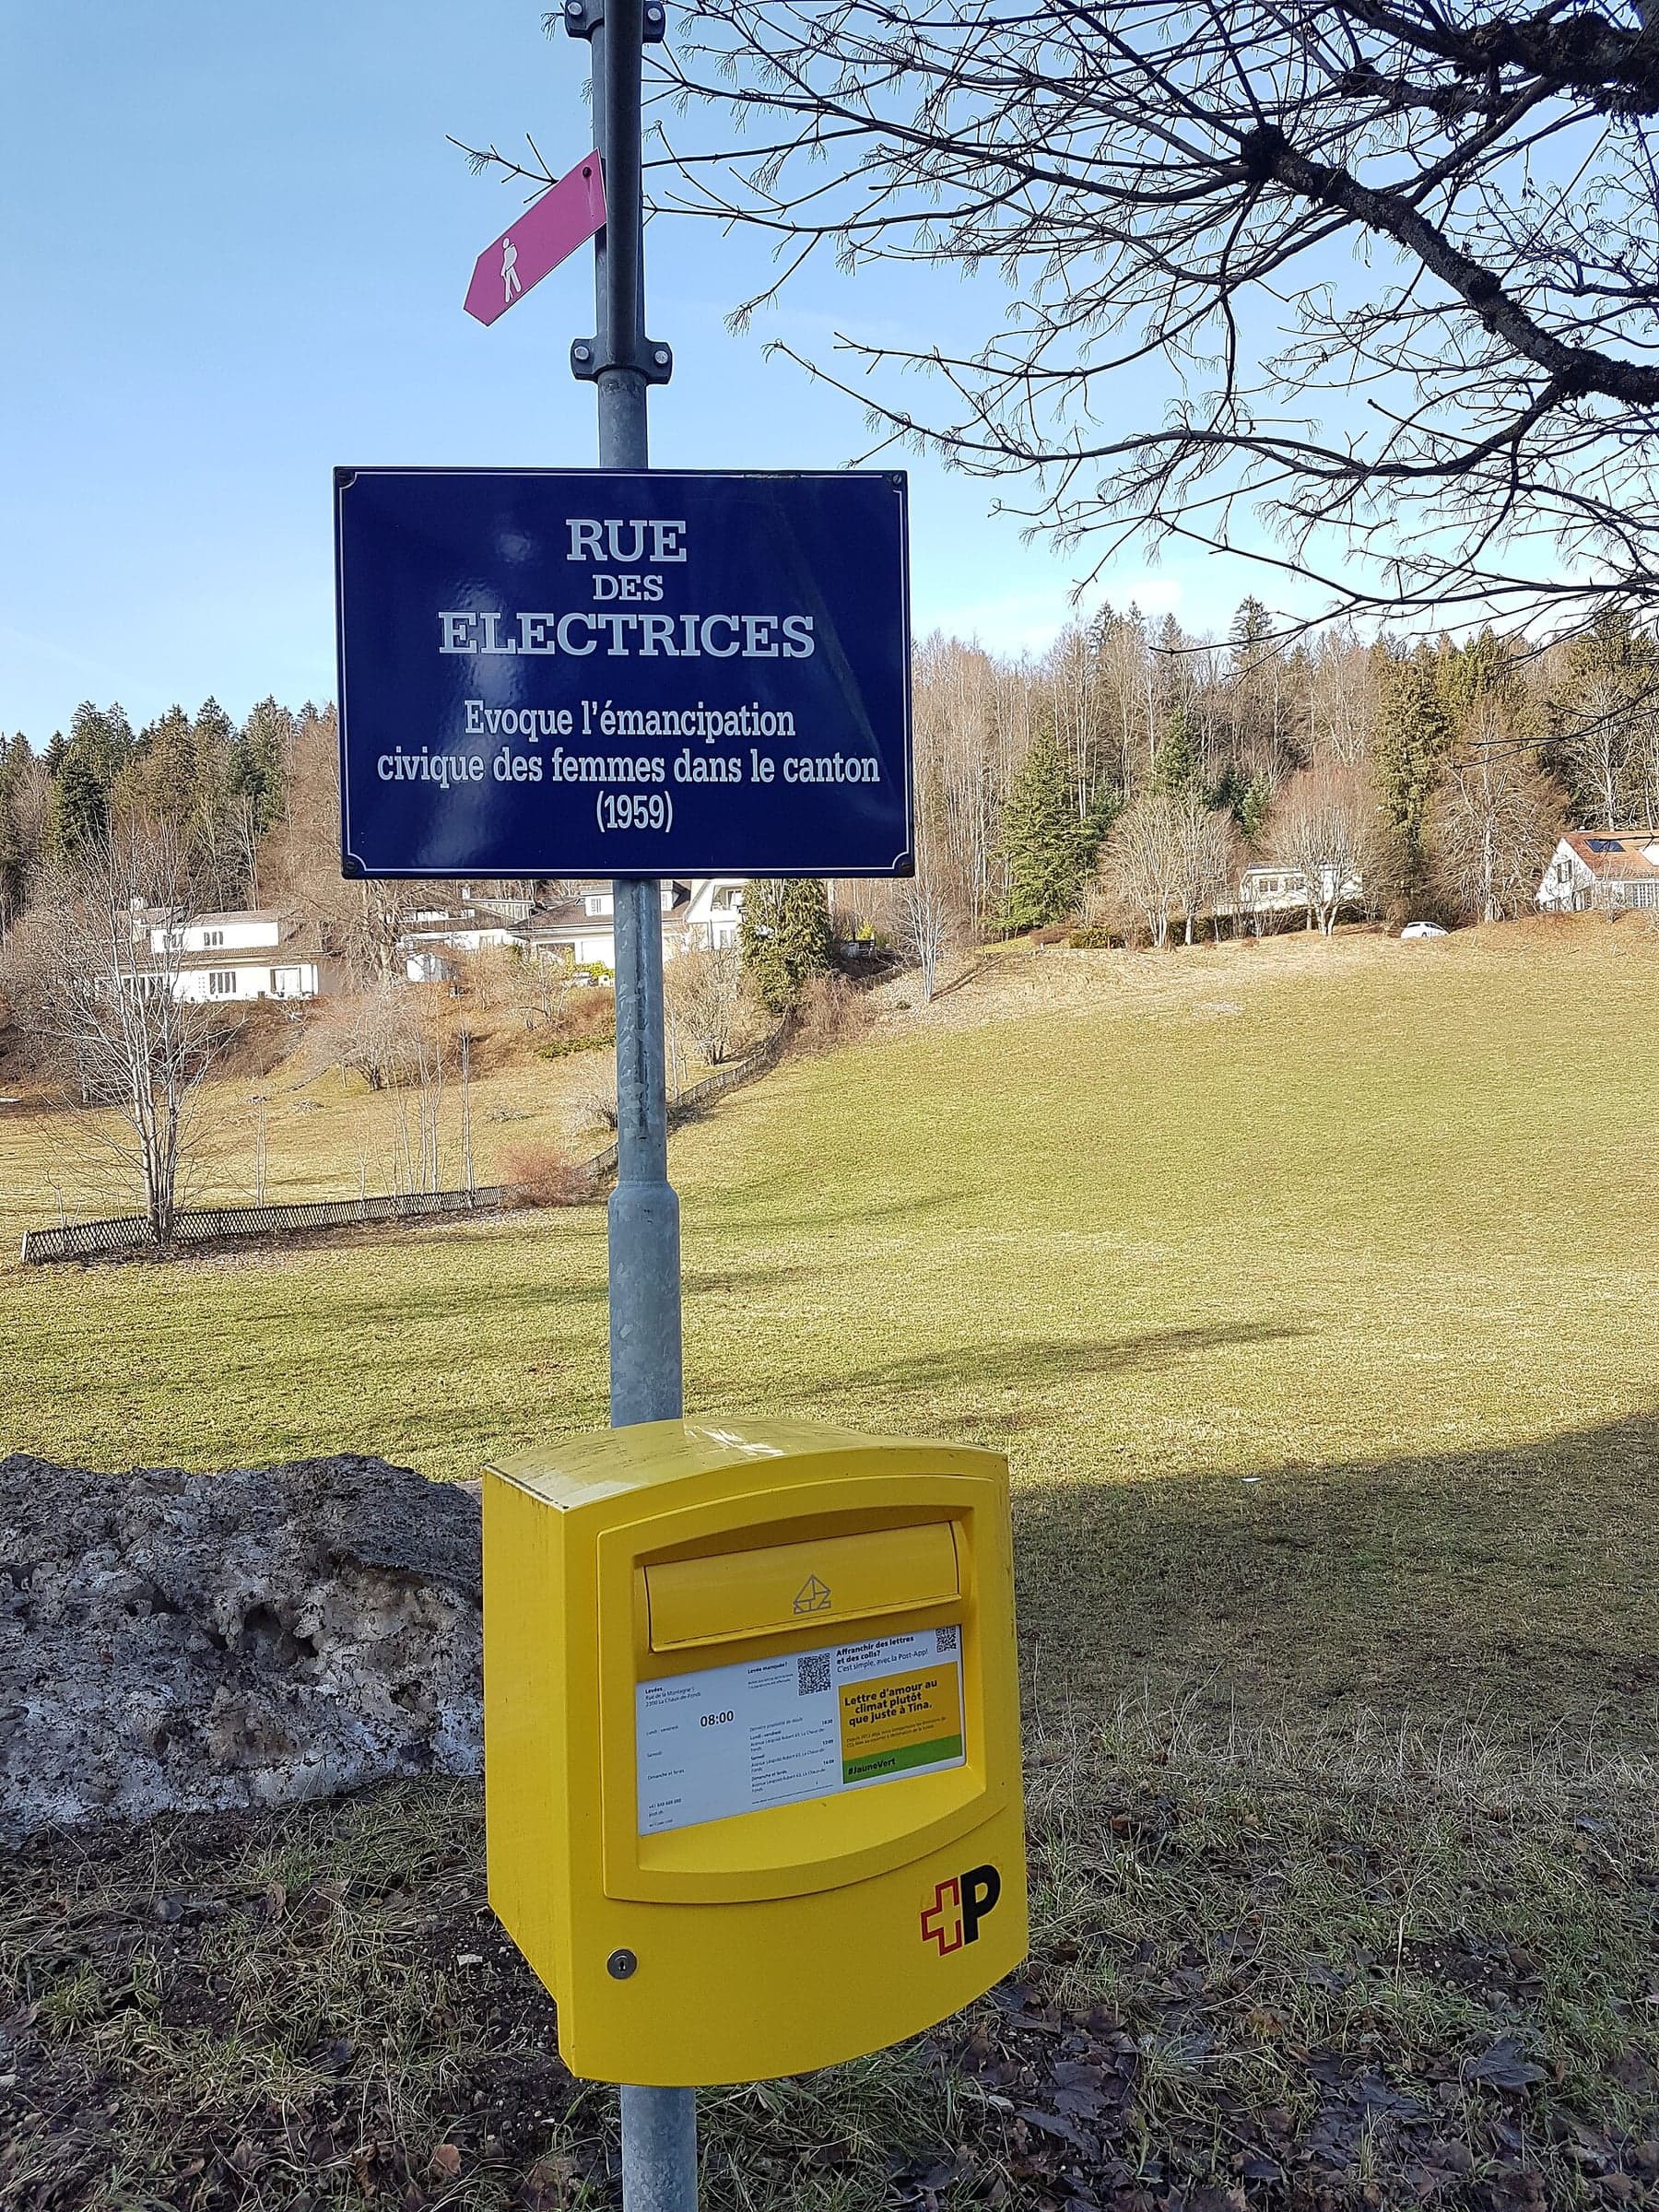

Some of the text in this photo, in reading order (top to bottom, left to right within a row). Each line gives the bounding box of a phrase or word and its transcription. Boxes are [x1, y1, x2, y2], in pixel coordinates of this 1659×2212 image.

[566, 518, 688, 562] RUE
[593, 574, 664, 601] DES
[438, 611, 815, 658] ELECTRICES
[465, 700, 795, 743] Evoque l'émancipation
[377, 747, 880, 789] civique des femmes dans le canton
[596, 791, 674, 833] (1959)
[836, 1635, 914, 1657] Affranchir des lettres
[846, 1654, 860, 1663] des
[861, 1650, 881, 1661] colis?
[853, 1659, 876, 1671] simple,
[898, 1649, 928, 1661] Post-App!
[844, 1692, 877, 1706] Lettre
[924, 1679, 937, 1689] au
[854, 1692, 923, 1714] climat plutôt
[700, 1711, 735, 1727] 08:00
[849, 1700, 932, 1728] que juste à Tina.
[848, 1758, 896, 1776] #JauneVert
[959, 1865, 1002, 1947] P
